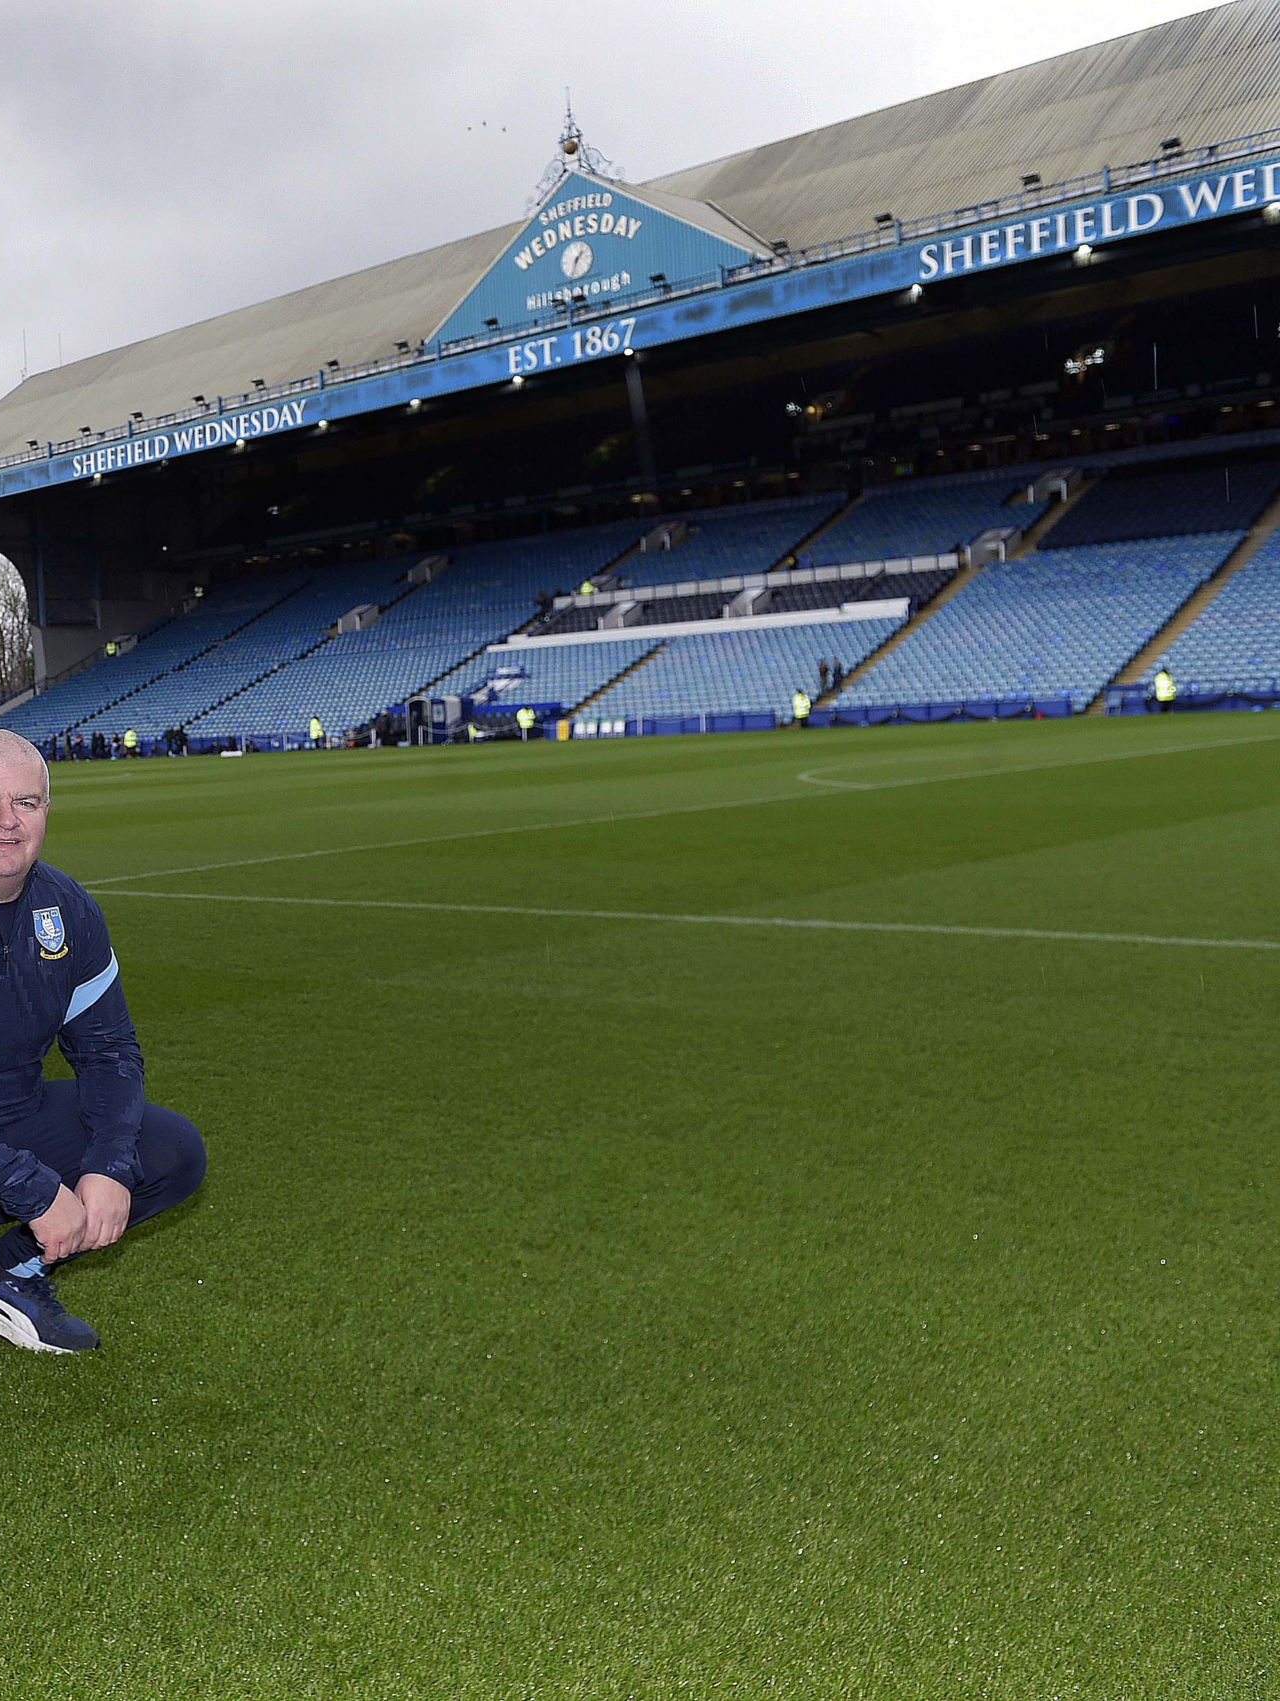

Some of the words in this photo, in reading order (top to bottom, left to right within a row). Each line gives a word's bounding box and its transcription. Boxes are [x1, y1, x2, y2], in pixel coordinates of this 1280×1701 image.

[539, 192, 613, 226] SHEFFIELD
[919, 193, 1164, 280] SHEFFIELD
[514, 213, 642, 271] WEDNESDAY
[526, 270, 631, 312] Hillsborough
[508, 336, 561, 374] EST.
[571, 317, 636, 359] 1867
[72, 435, 170, 477] SHEFFIELD
[174, 400, 307, 452] WEDNESDAY
